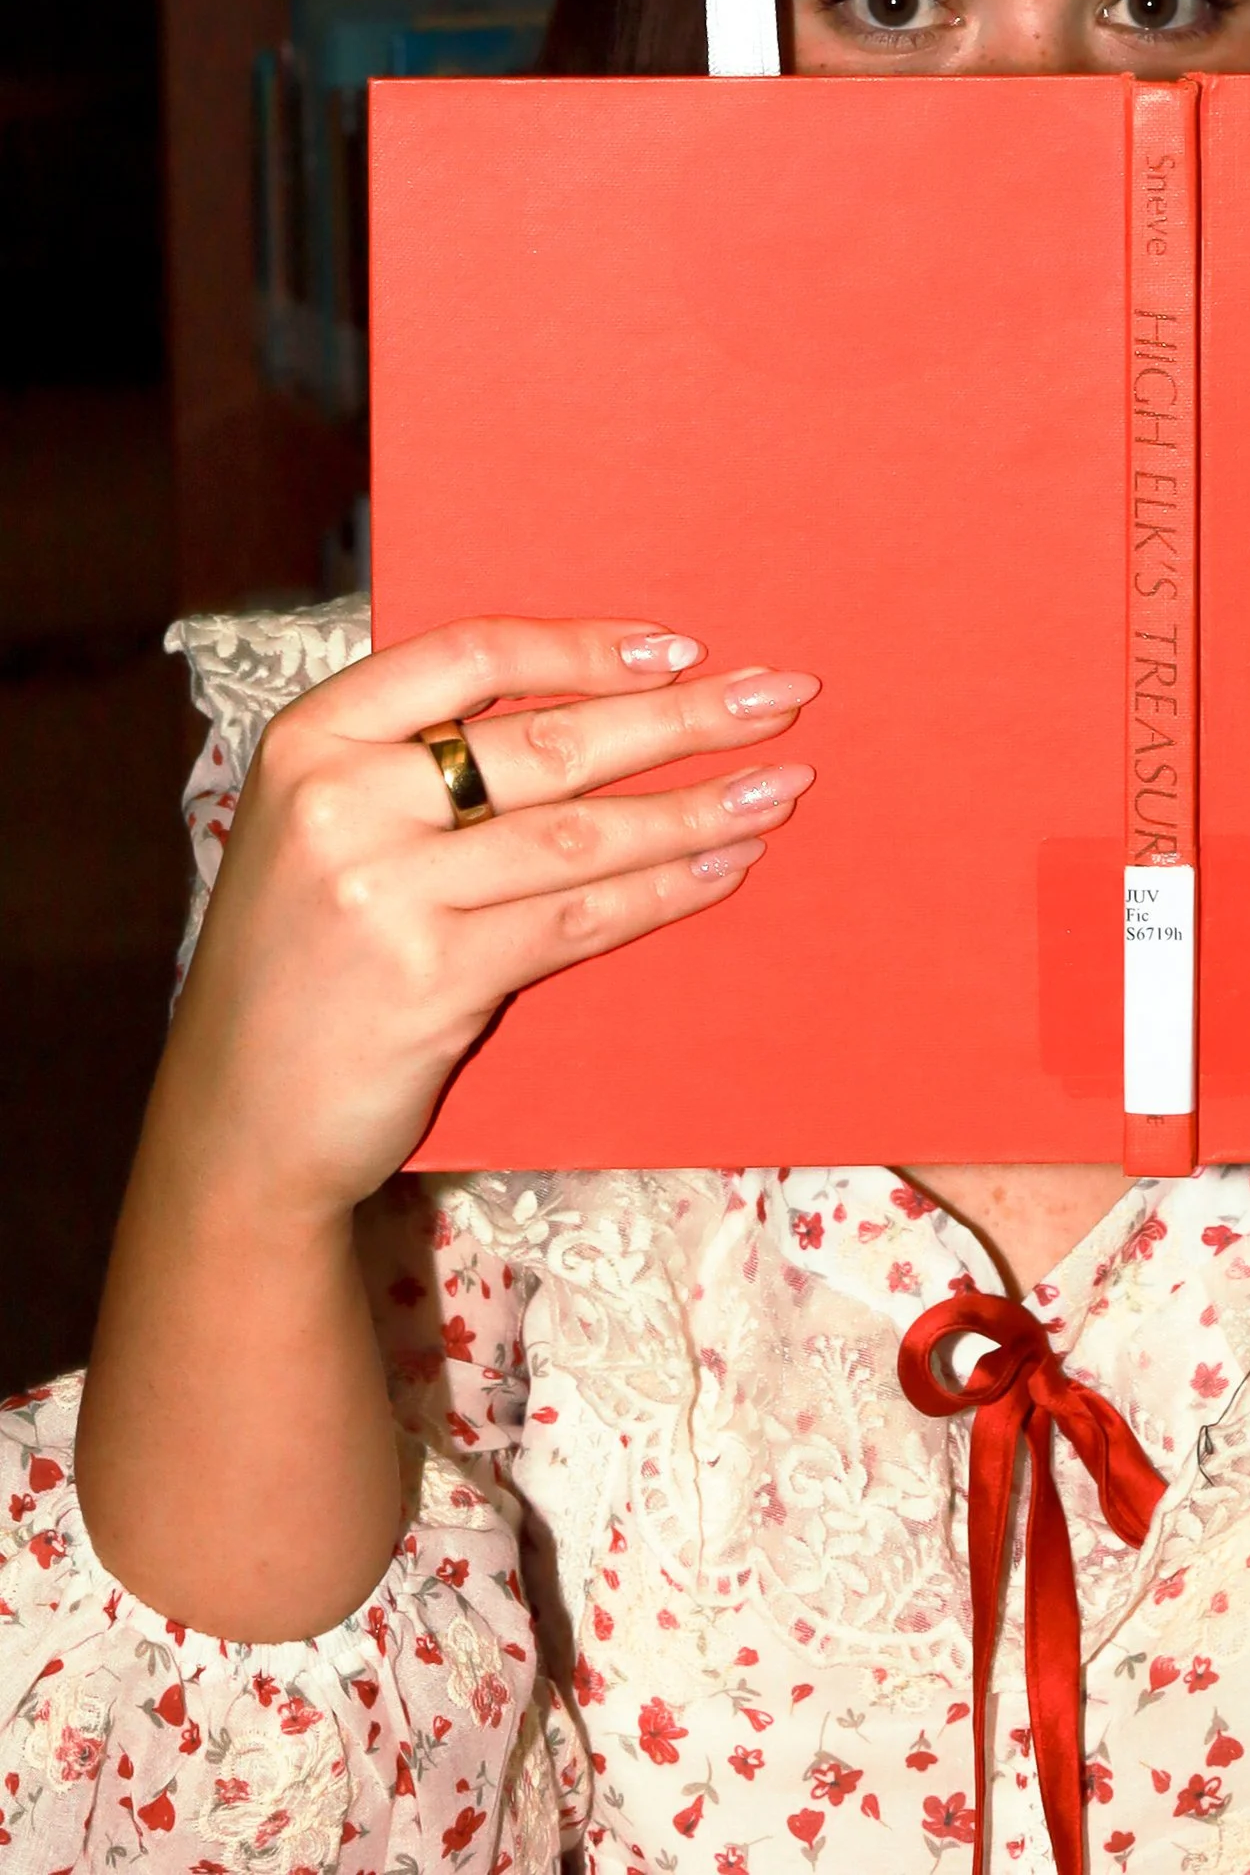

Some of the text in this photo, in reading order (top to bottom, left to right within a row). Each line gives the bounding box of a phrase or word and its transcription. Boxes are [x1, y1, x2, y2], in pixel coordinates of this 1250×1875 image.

[1144, 153, 1177, 258] Sneve
[1133, 308, 1179, 866] HIGH ELK'S TREASUR
[1125, 889, 1160, 904] JUV
[1125, 908, 1150, 923] Fic
[1125, 926, 1183, 942] S6719h
